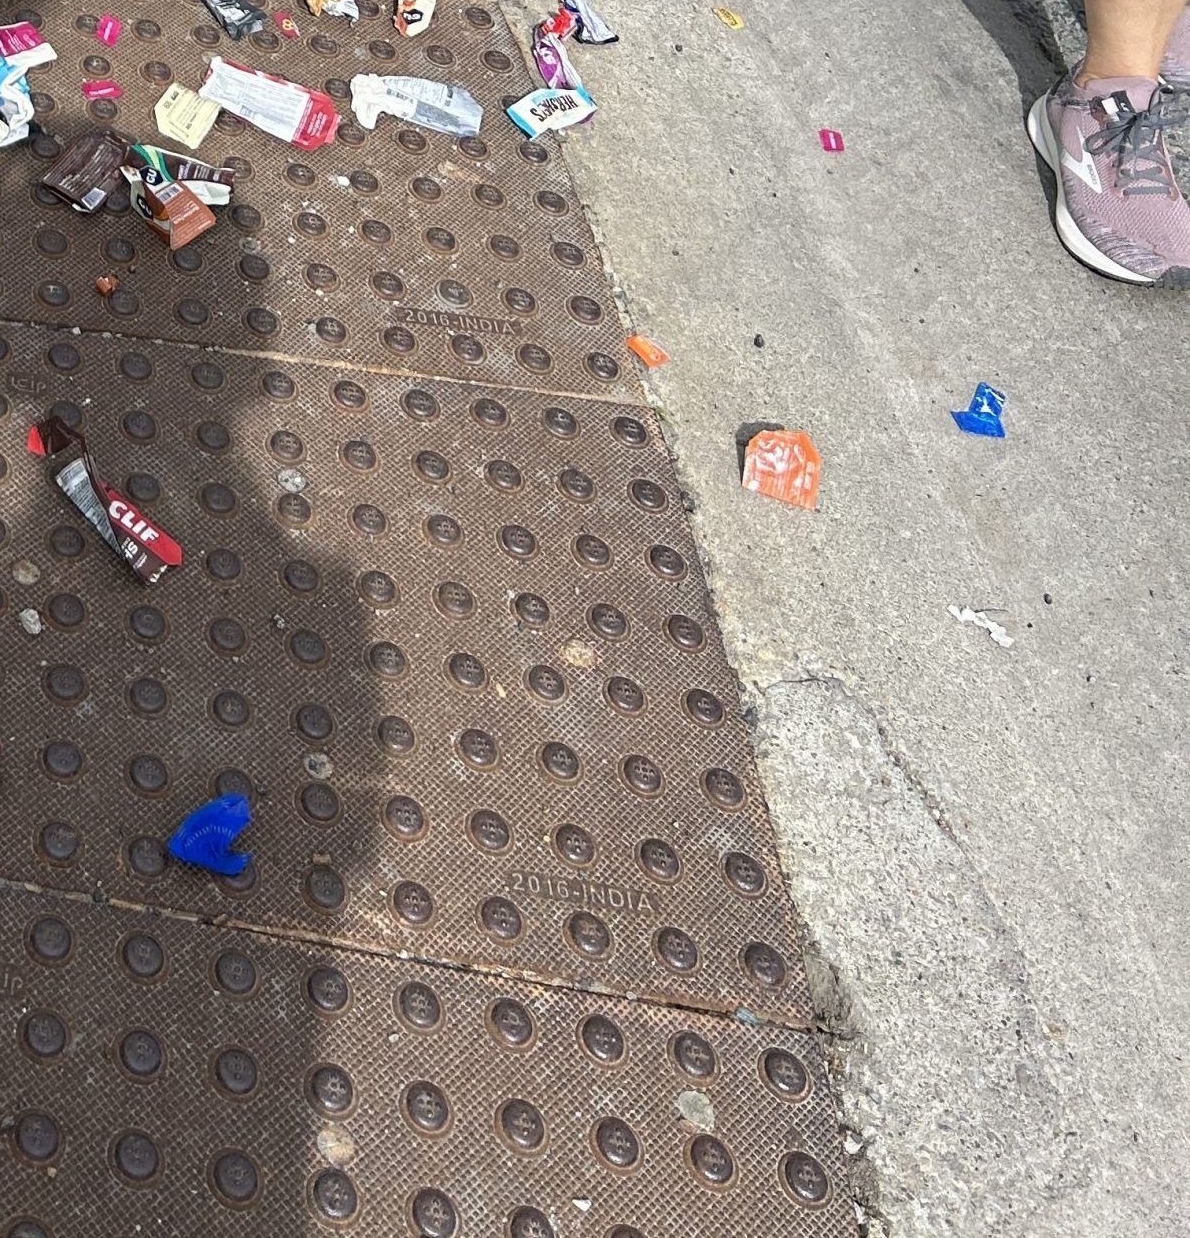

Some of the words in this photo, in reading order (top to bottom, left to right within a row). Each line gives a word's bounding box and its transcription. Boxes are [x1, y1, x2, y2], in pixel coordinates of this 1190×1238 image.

[146, 168, 159, 184] GU
[109, 499, 159, 543] CLIF
[512, 872, 653, 913] 2016-INDIA
